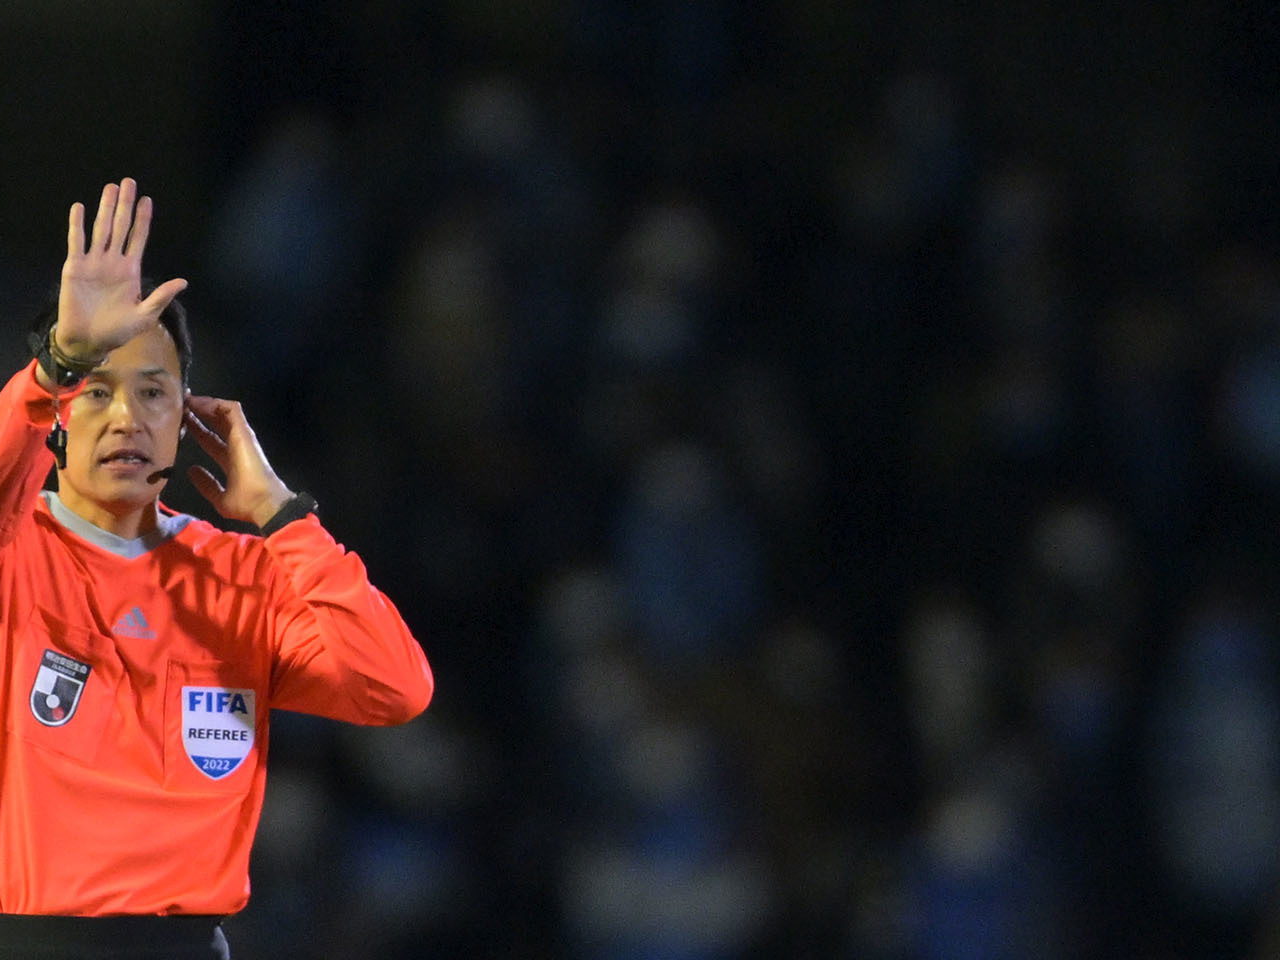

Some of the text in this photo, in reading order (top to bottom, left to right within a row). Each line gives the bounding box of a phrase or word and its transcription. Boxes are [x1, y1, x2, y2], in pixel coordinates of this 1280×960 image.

[189, 691, 248, 714] FIFA
[188, 728, 248, 741] REFEREE
[202, 759, 230, 770] 2022
